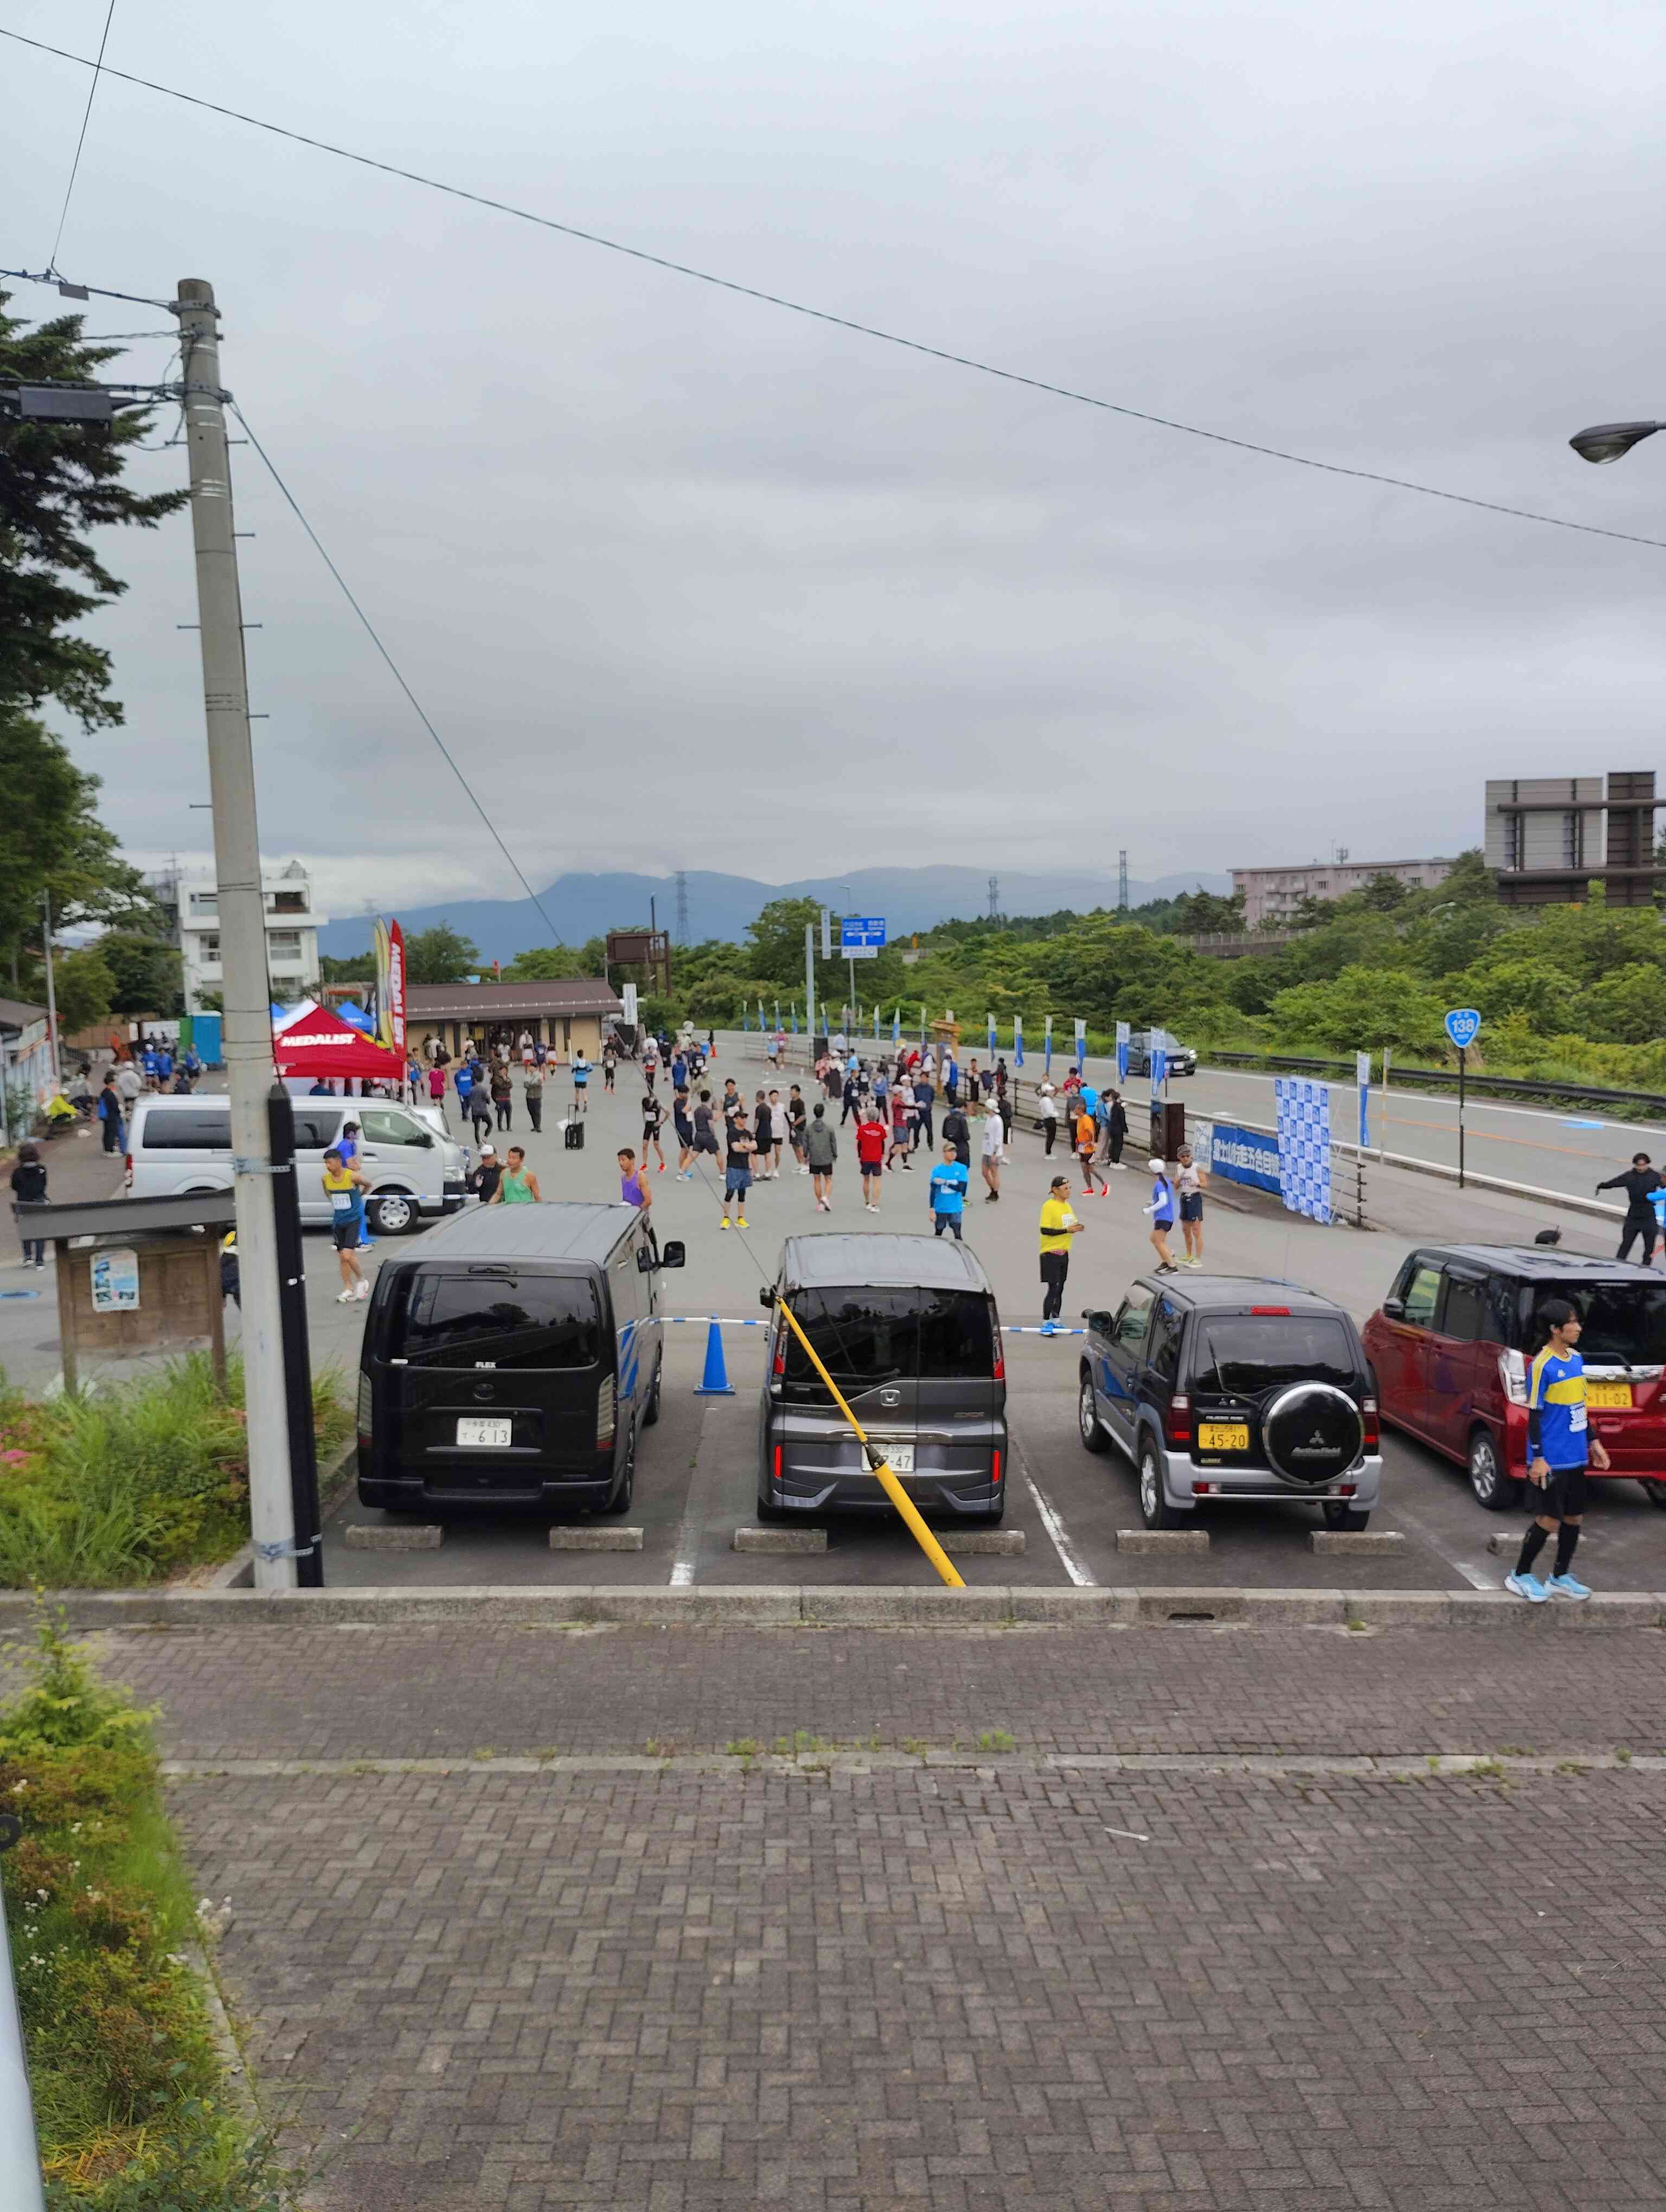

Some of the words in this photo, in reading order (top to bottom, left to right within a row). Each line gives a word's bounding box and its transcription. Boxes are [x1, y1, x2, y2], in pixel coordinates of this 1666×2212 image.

[1451, 1018, 1475, 1033] 138
[280, 1033, 356, 1047] MEDALIST
[1209, 1434, 1246, 1447] 45-20
